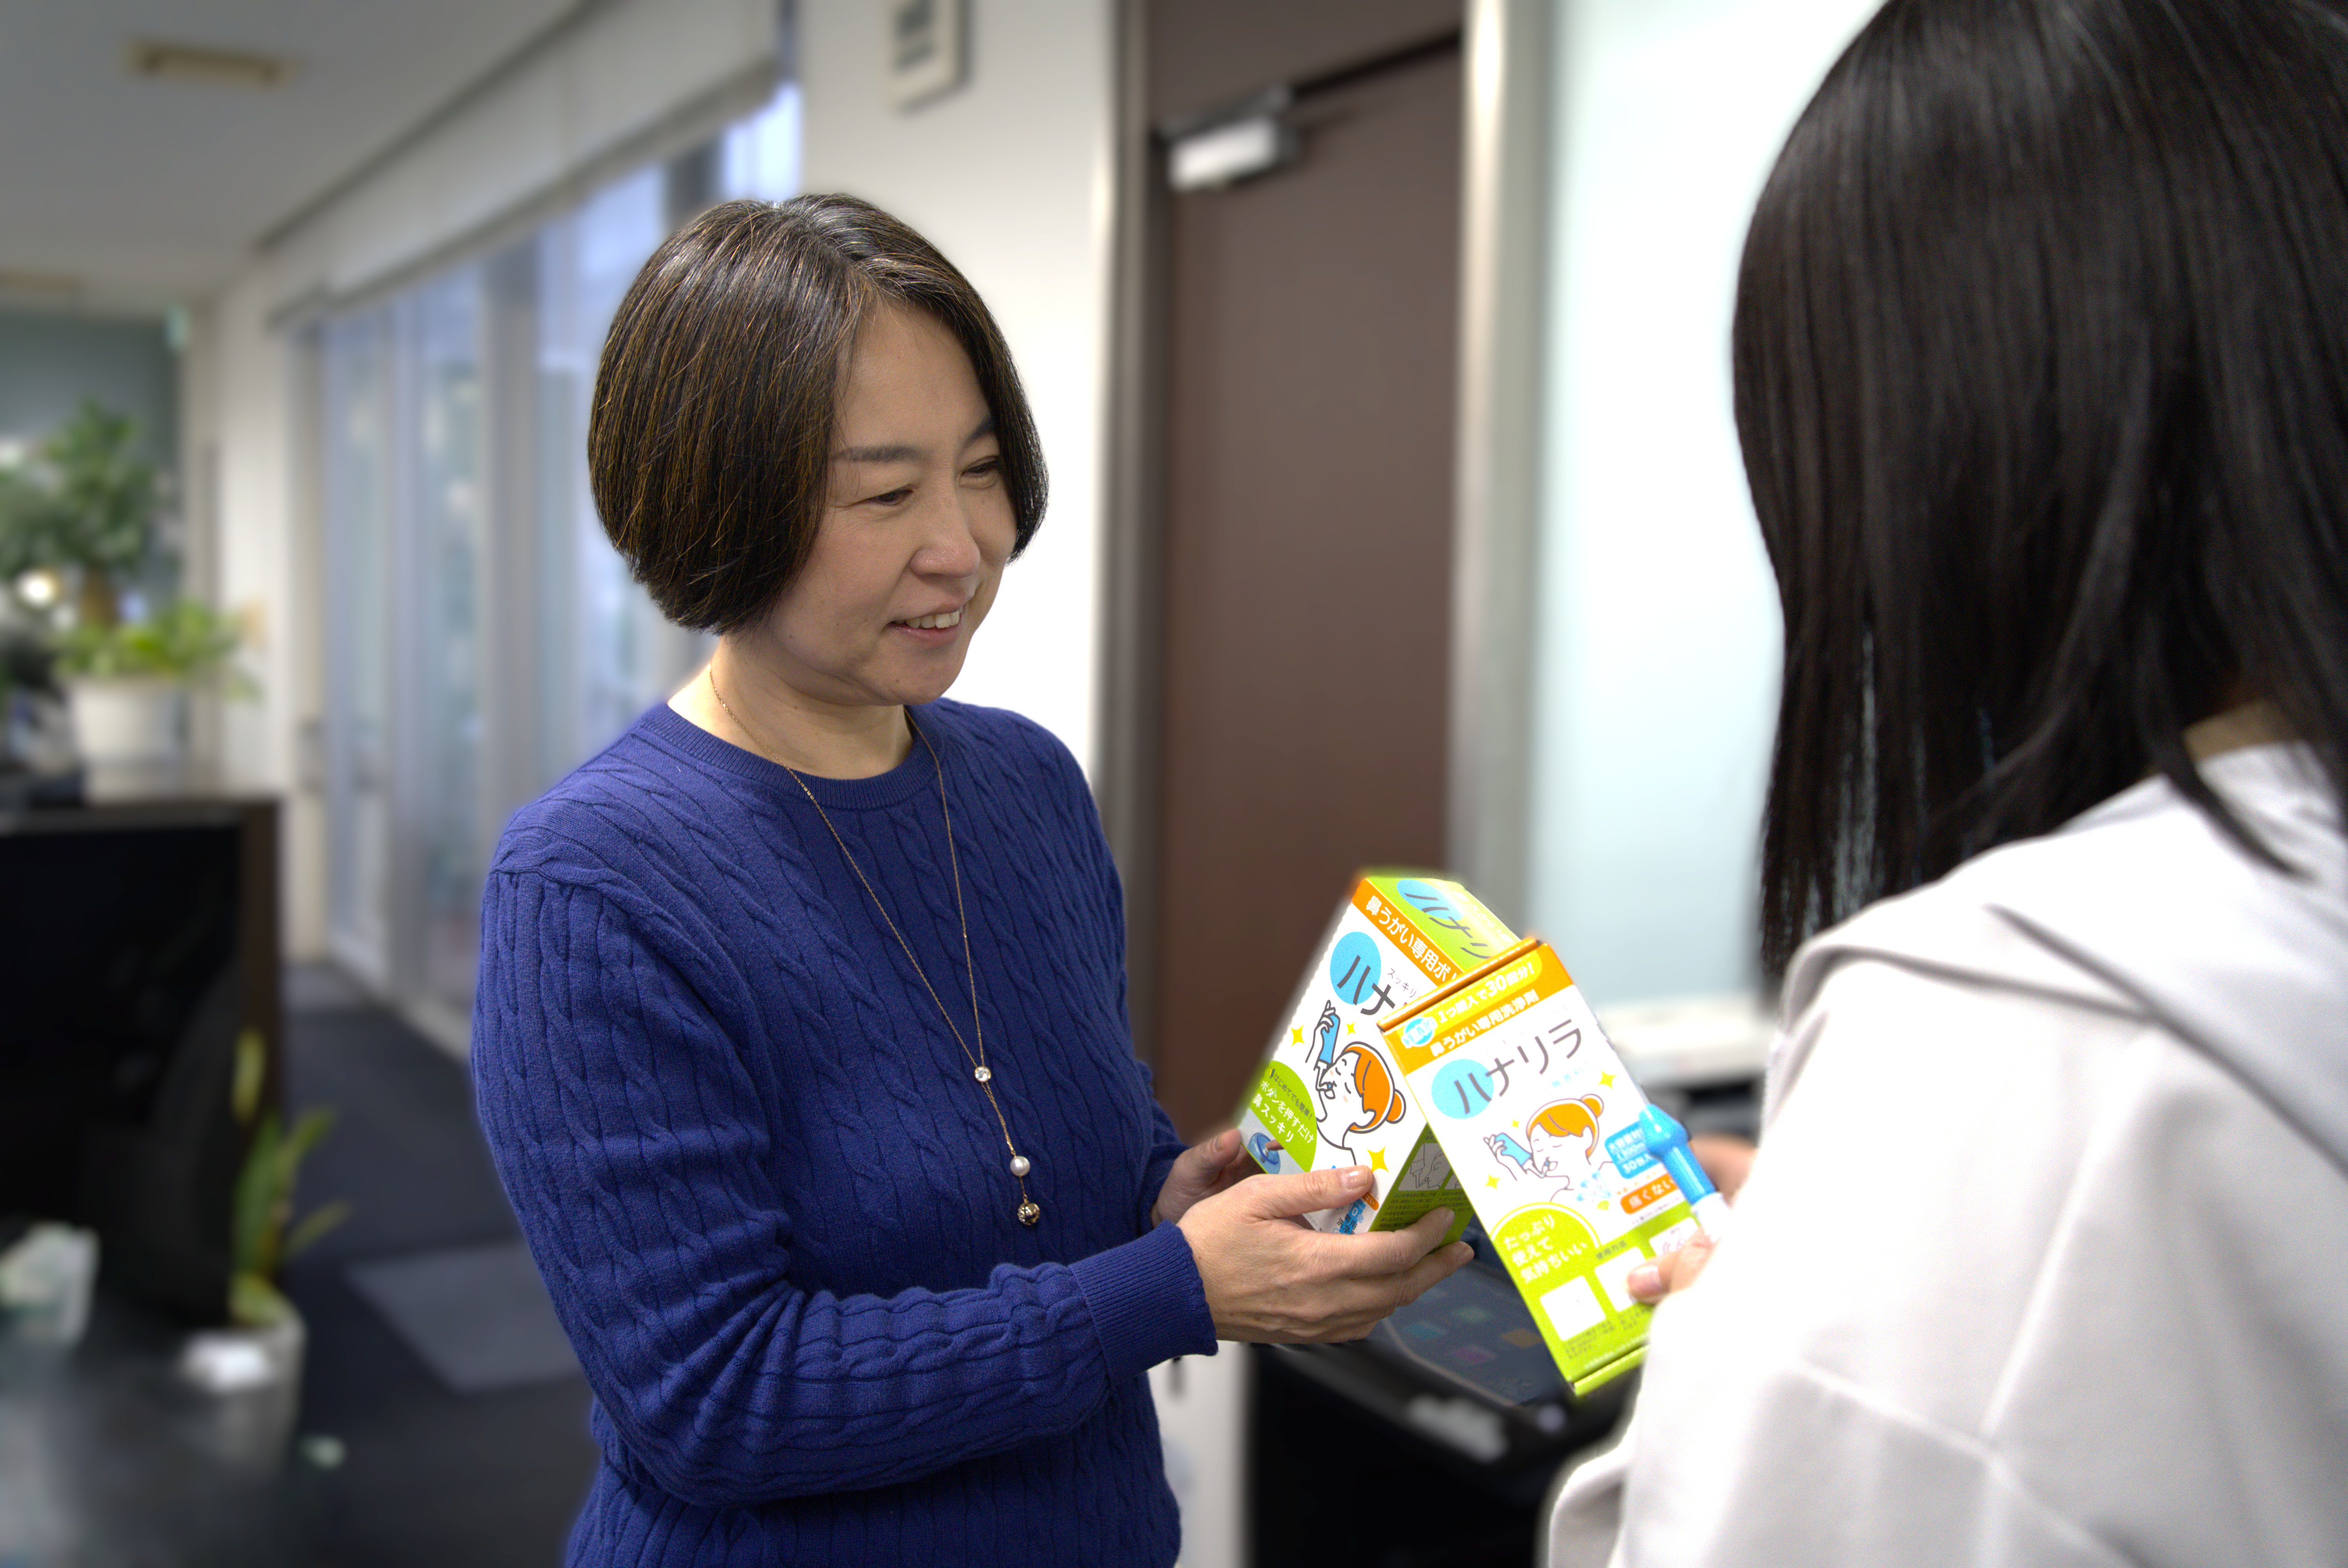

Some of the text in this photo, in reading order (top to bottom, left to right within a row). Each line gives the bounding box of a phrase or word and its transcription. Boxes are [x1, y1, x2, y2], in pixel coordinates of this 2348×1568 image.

[1365, 895, 1458, 982] 鼻うがい専用ボ
[1337, 955, 1408, 1016] ハナ
[1387, 968, 1421, 999] スッキリ
[1453, 1018, 1582, 1115] ハナリラ
[1252, 1093, 1294, 1142] 鼻スッキリ
[1261, 1080, 1314, 1143] ボタンを押すだけ
[1503, 1213, 1555, 1251] たっぷり
[1520, 1242, 1588, 1285] 気持ちいい
